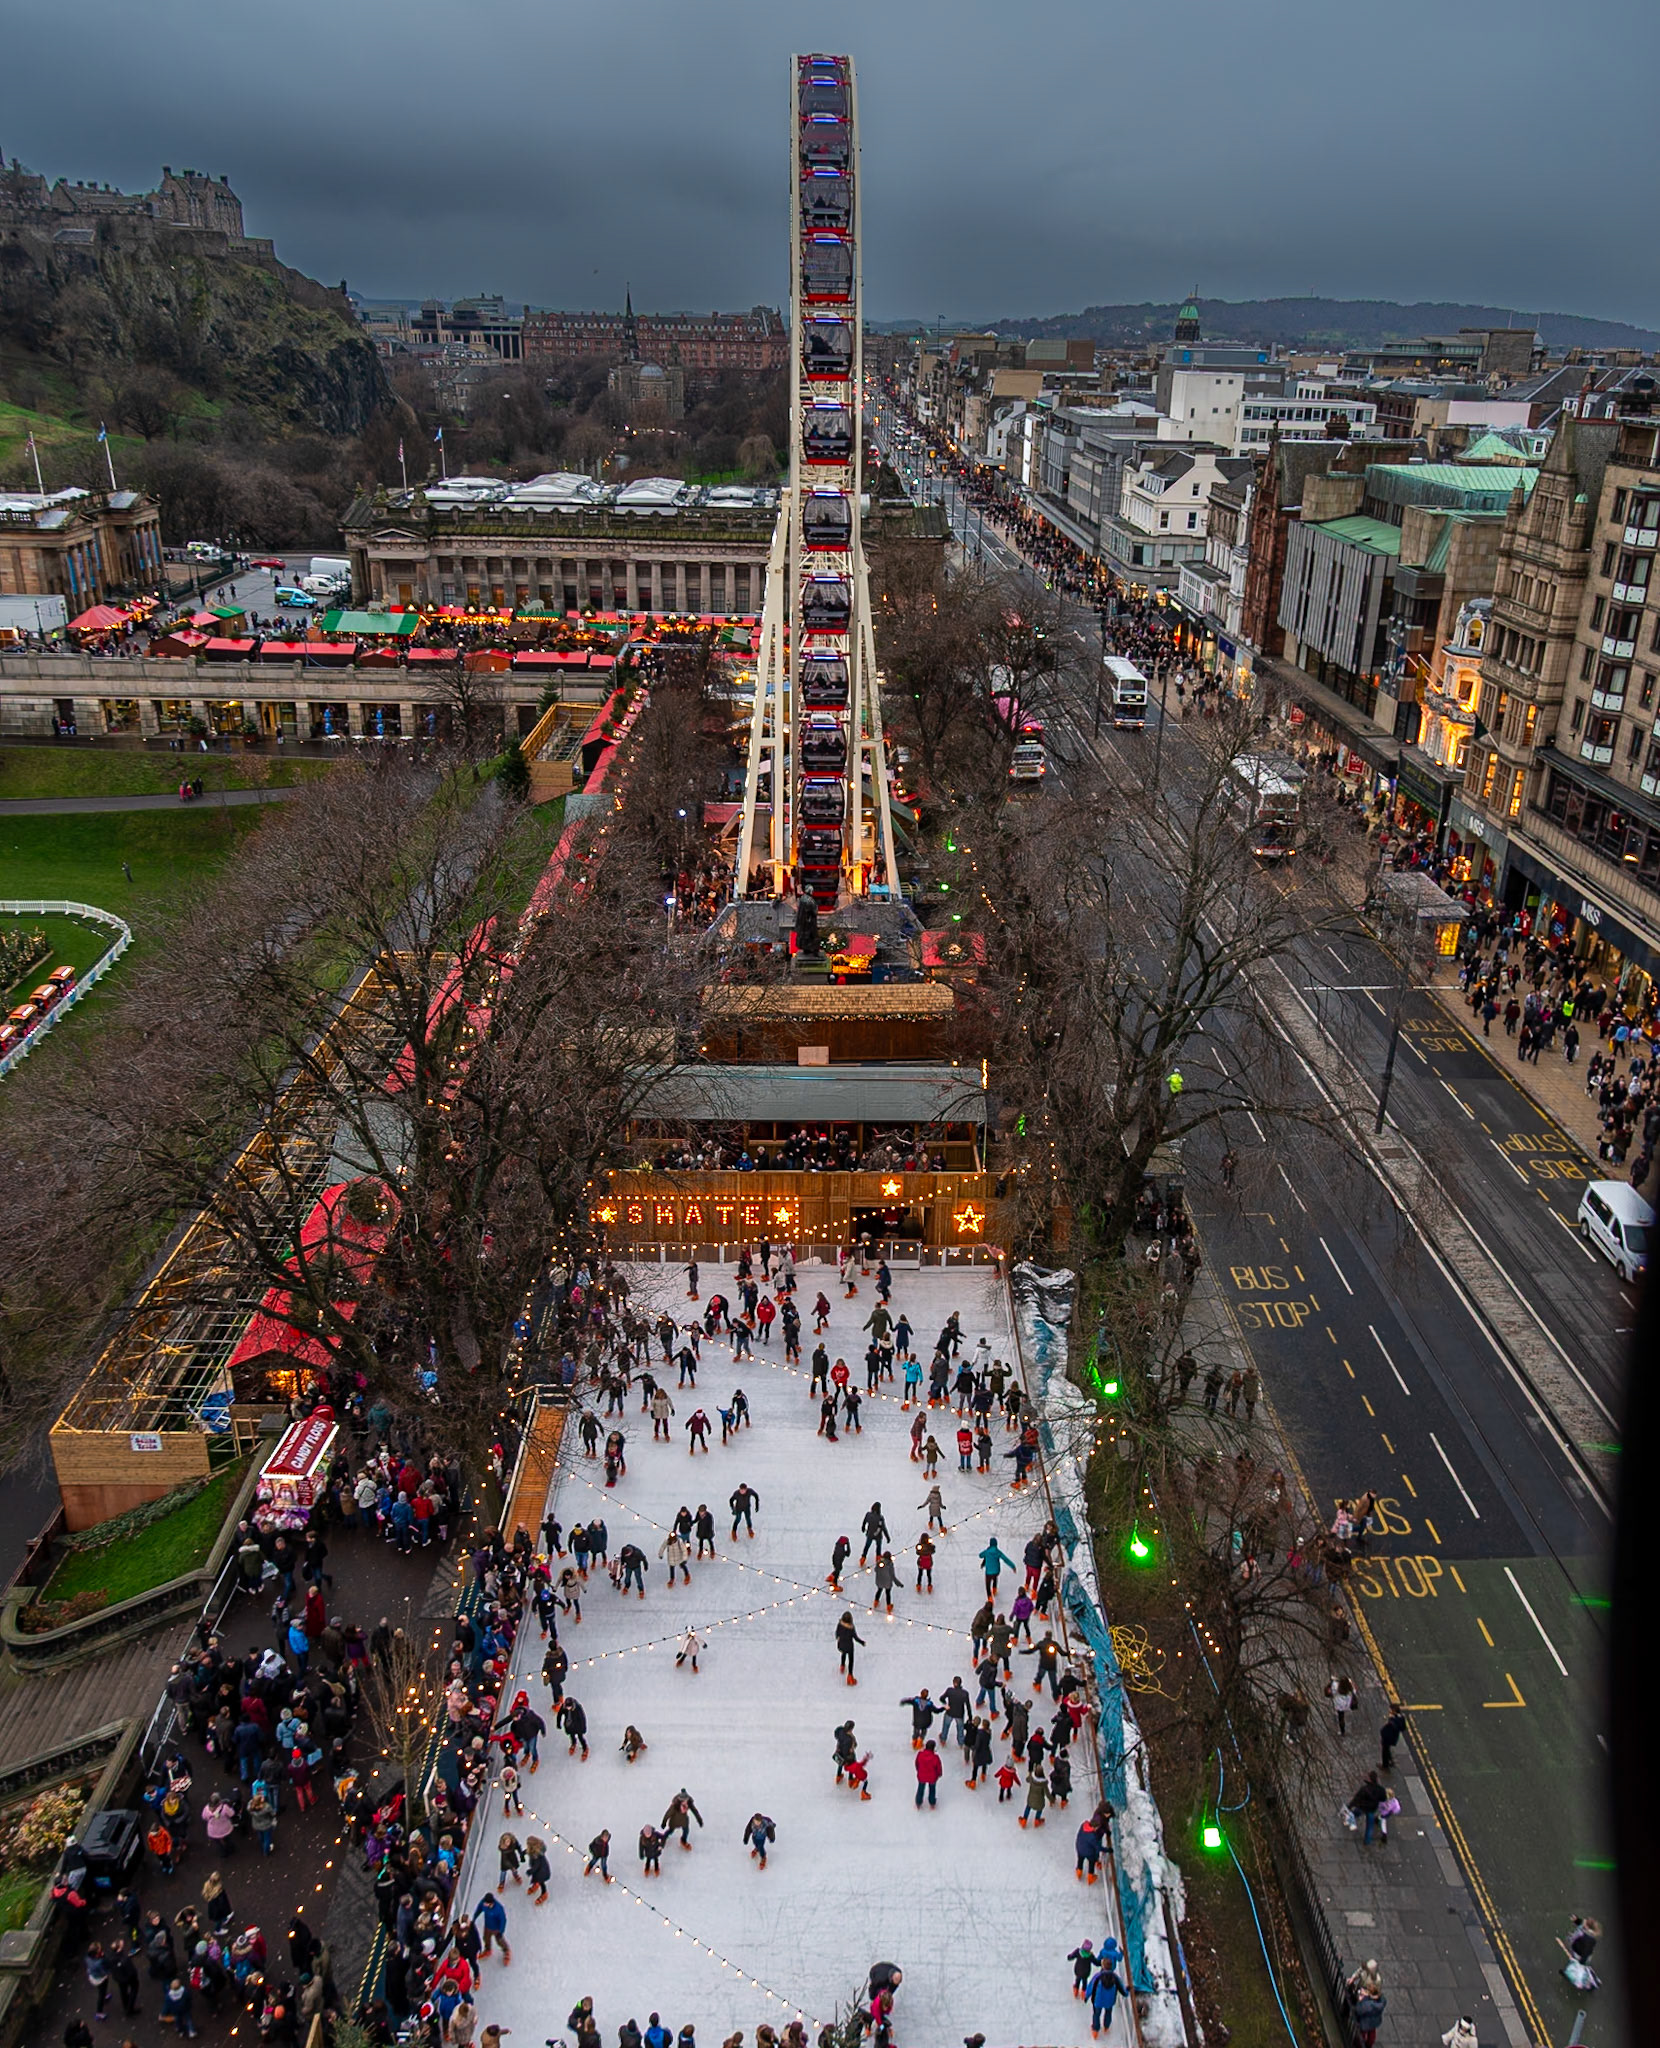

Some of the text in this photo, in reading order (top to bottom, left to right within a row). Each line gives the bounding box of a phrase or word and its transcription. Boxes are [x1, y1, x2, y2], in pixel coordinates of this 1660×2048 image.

[1580, 899, 1602, 927] M&S
[1402, 1018, 1456, 1033] STOP
[1420, 1037, 1468, 1052] BUS
[1504, 1133, 1568, 1153] STOP
[1528, 1159, 1587, 1180] BUS
[627, 1203, 761, 1225] SKATE
[1229, 1265, 1291, 1290] BUS
[1237, 1301, 1311, 1329] STOP
[290, 1442, 314, 1470] CANDY
[304, 1420, 328, 1445] FLOSS
[1351, 1555, 1444, 1598] STOP
